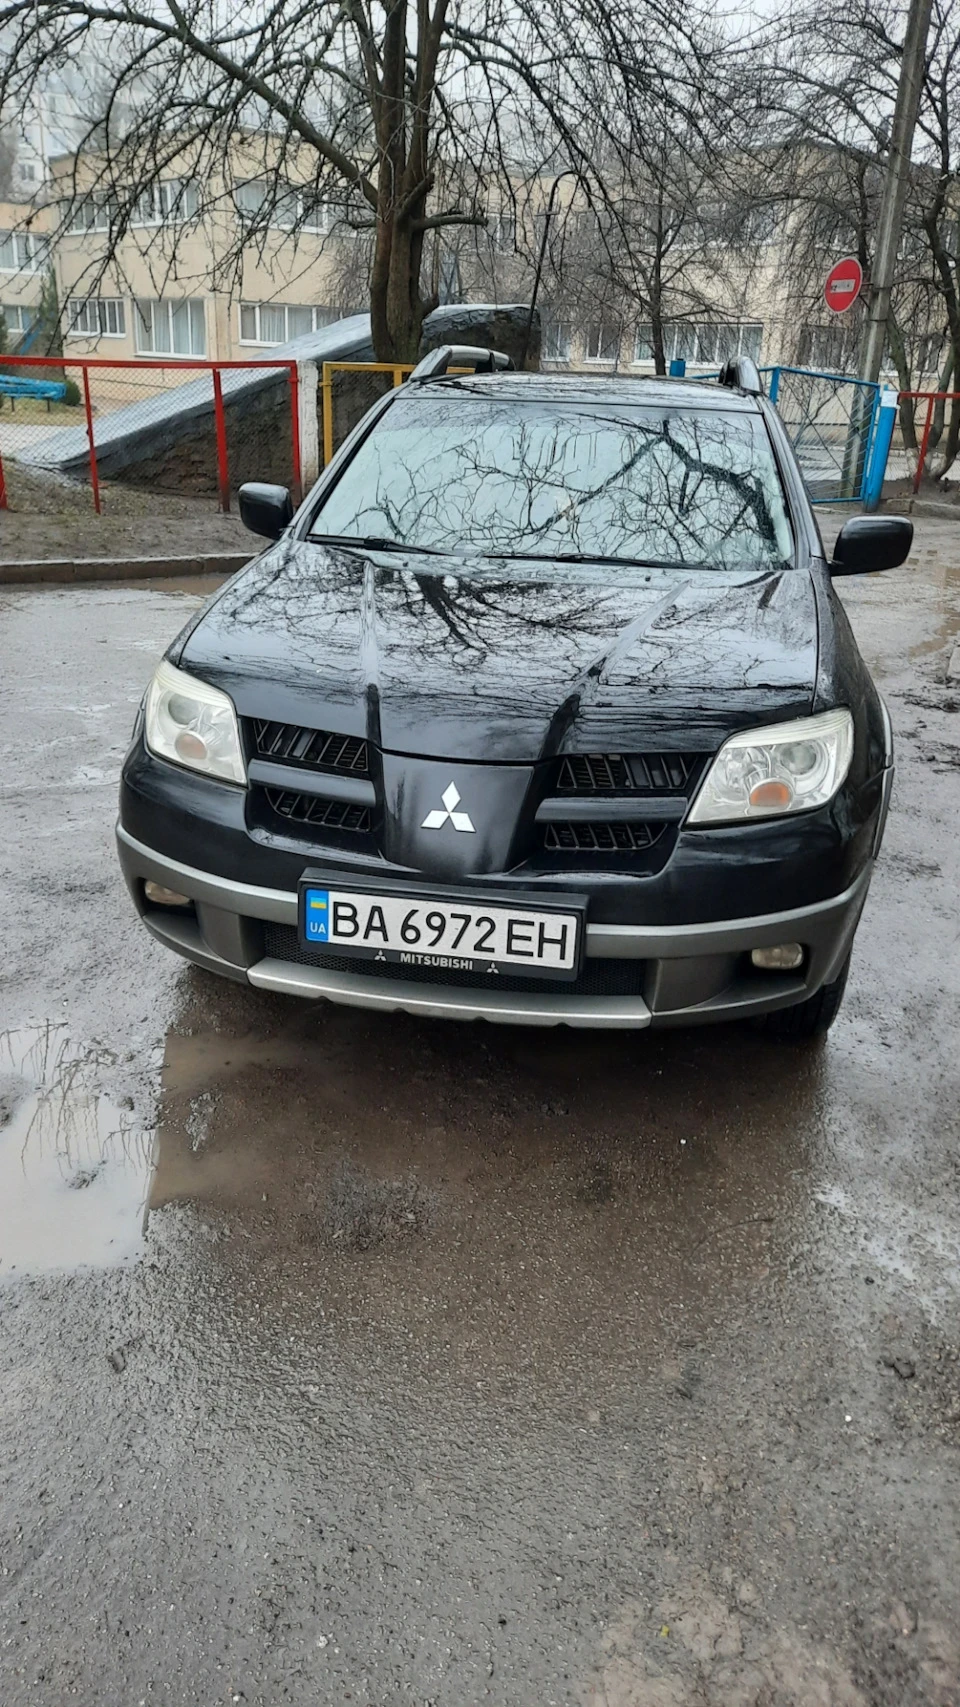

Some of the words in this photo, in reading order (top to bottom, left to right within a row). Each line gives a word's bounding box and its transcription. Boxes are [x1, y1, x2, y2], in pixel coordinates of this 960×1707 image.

[310, 921, 327, 935] UA
[332, 901, 389, 942] BA
[400, 909, 497, 954] 6972
[506, 918, 569, 961] EH
[400, 953, 473, 971] MITSUBISHI
